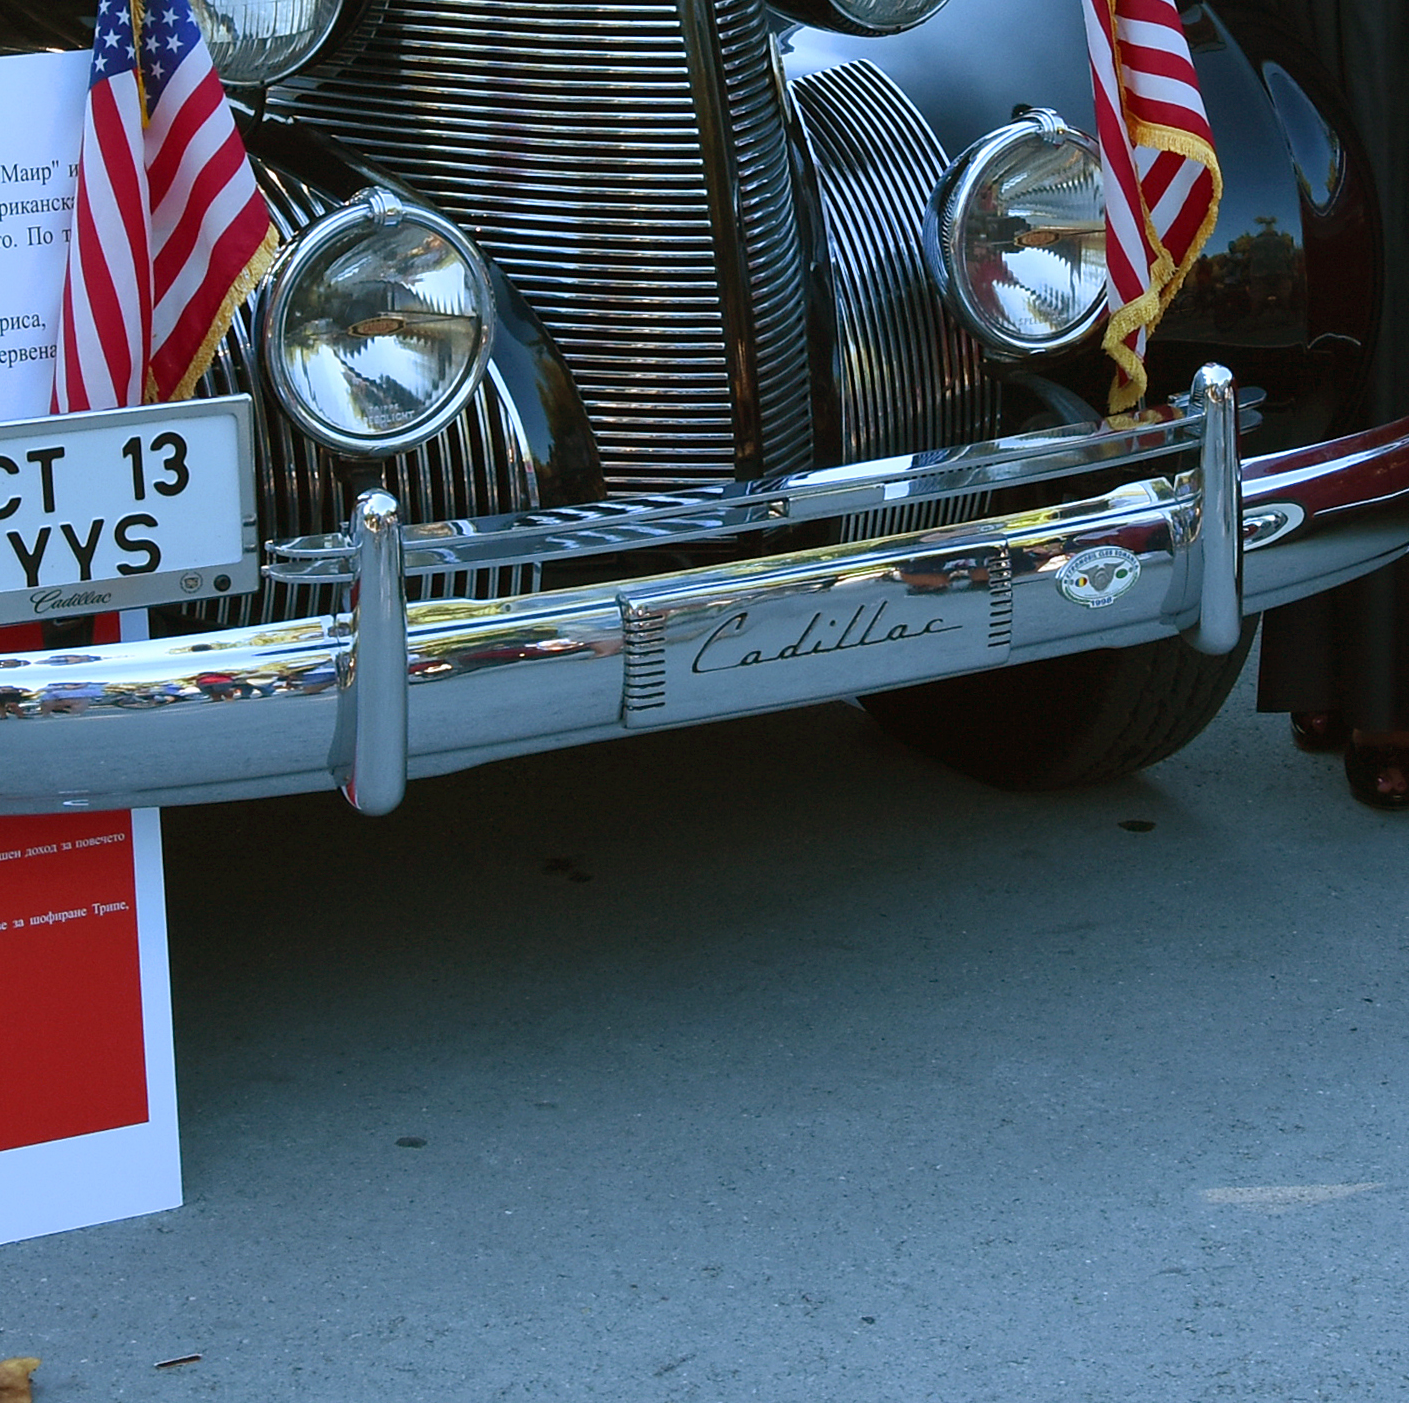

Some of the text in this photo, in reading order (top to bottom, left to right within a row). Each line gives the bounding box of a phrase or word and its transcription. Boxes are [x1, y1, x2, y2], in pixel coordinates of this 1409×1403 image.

[0, 159, 60, 186] Маир"
[27, 225, 54, 247] По
[122, 431, 190, 501] 13
[6, 513, 162, 588] YYS
[29, 588, 112, 614] Cadillac
[1091, 596, 1112, 607] 1998
[691, 599, 964, 674] Cadillac
[24, 843, 58, 858] доход
[59, 841, 73, 851] за
[74, 832, 126, 849] повечето
